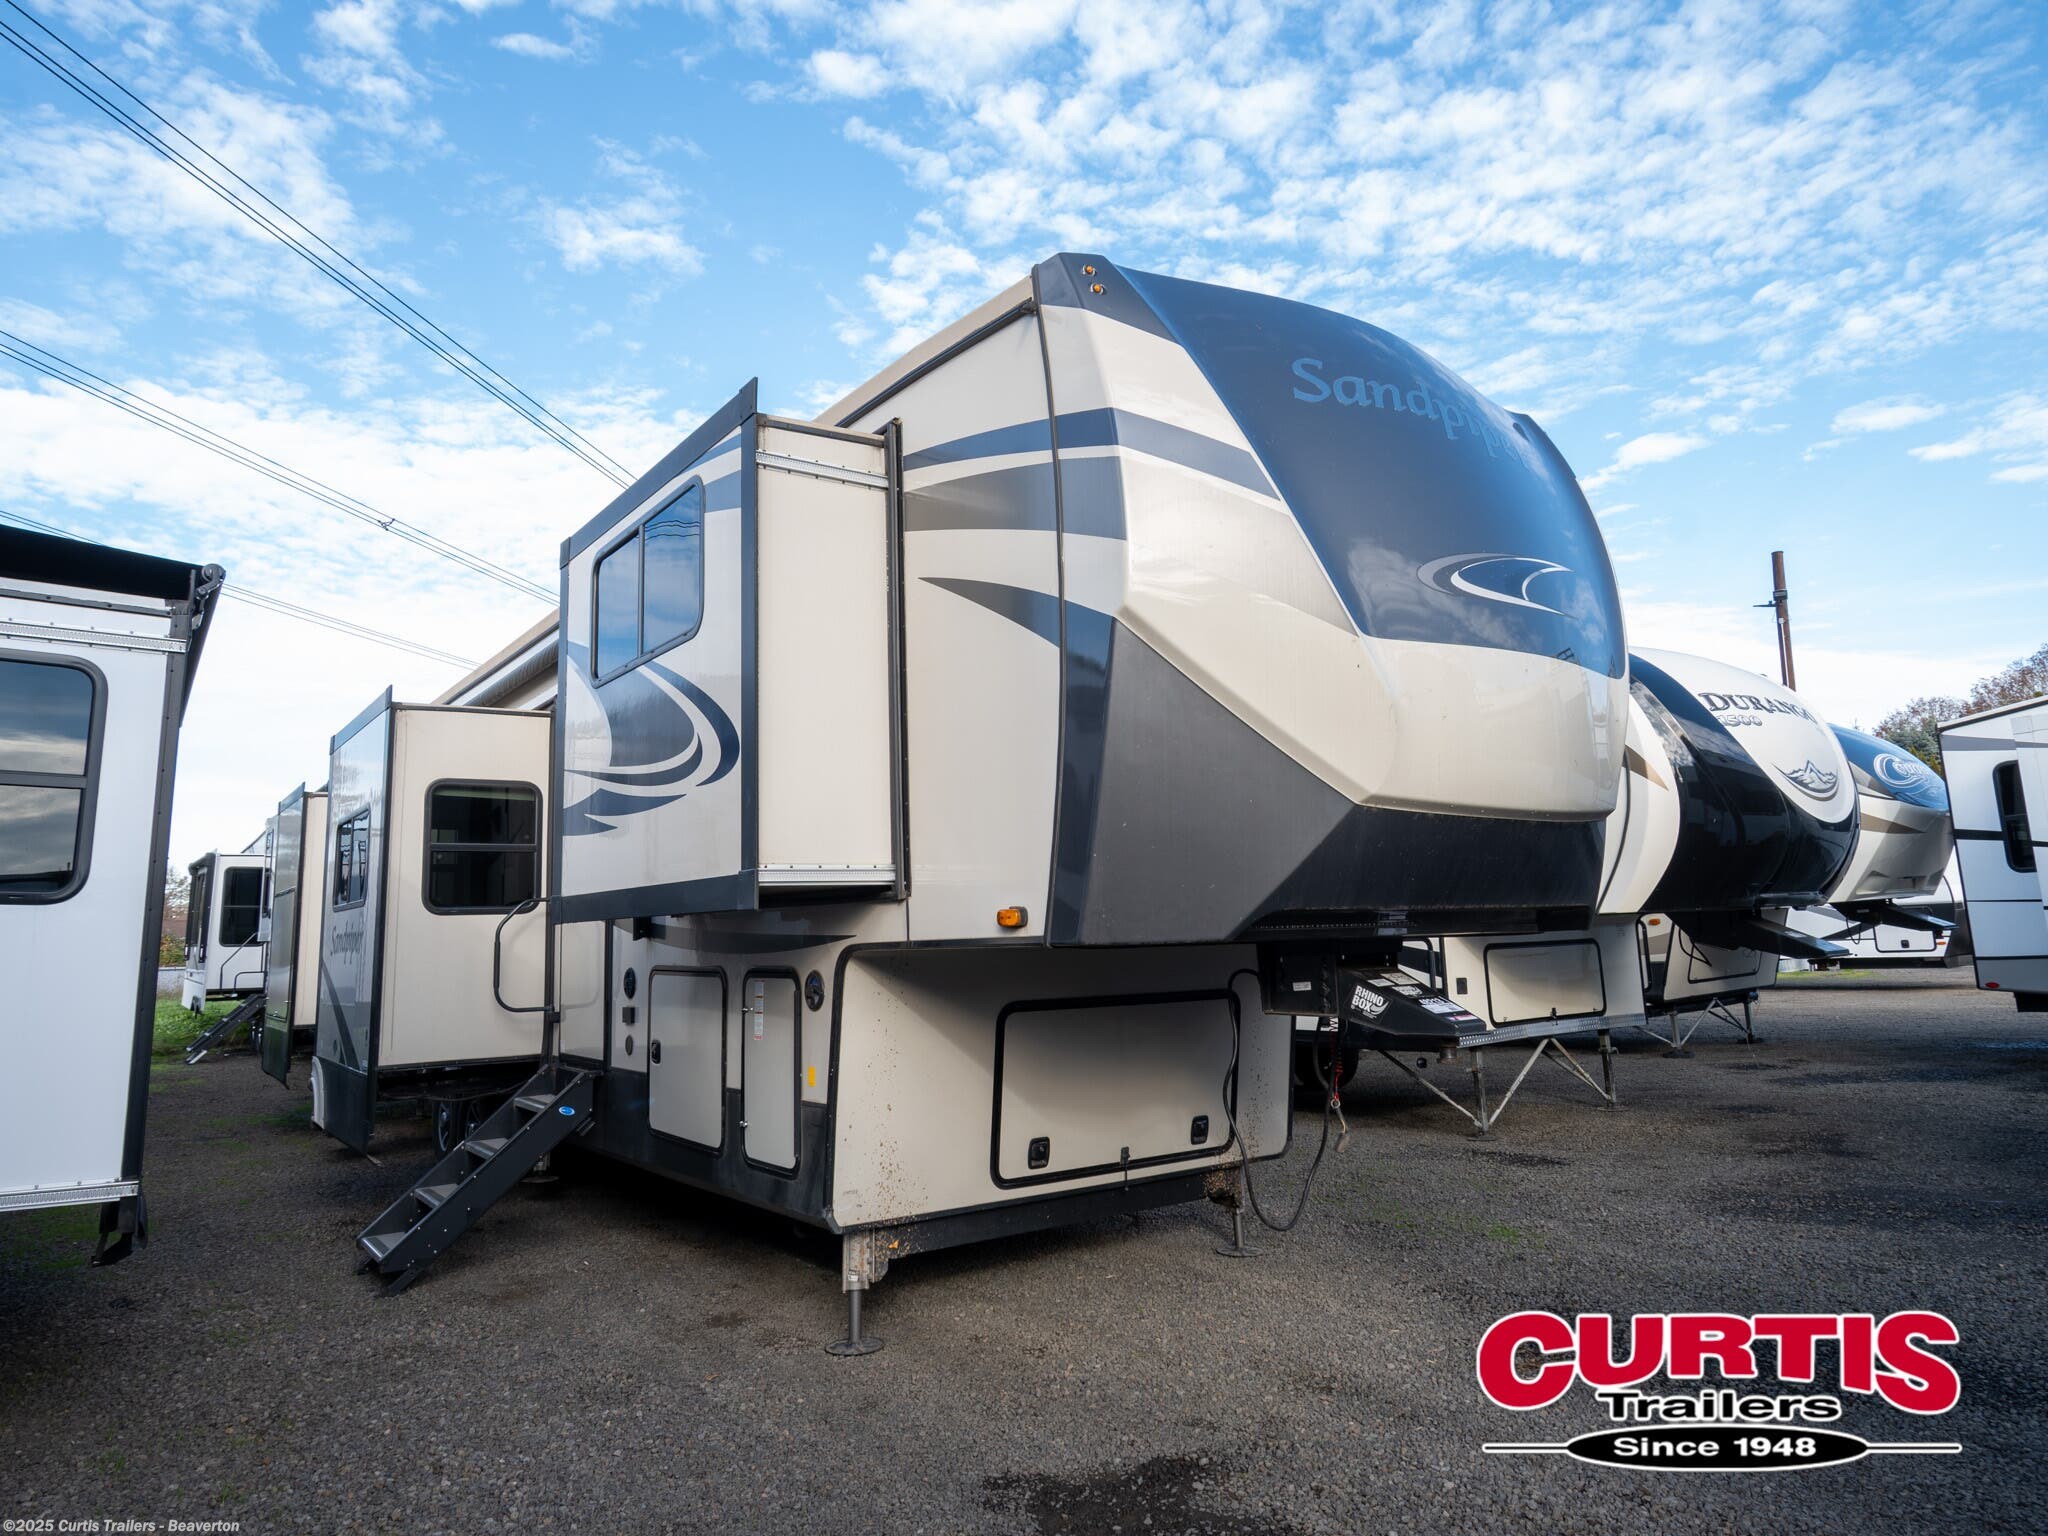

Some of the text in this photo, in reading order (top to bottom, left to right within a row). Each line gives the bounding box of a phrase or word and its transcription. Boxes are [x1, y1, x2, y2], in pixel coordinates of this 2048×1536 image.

[1291, 357, 1526, 468] Sandpip
[1351, 994, 1373, 1013] BOX
[1354, 984, 1384, 1007] RHINO
